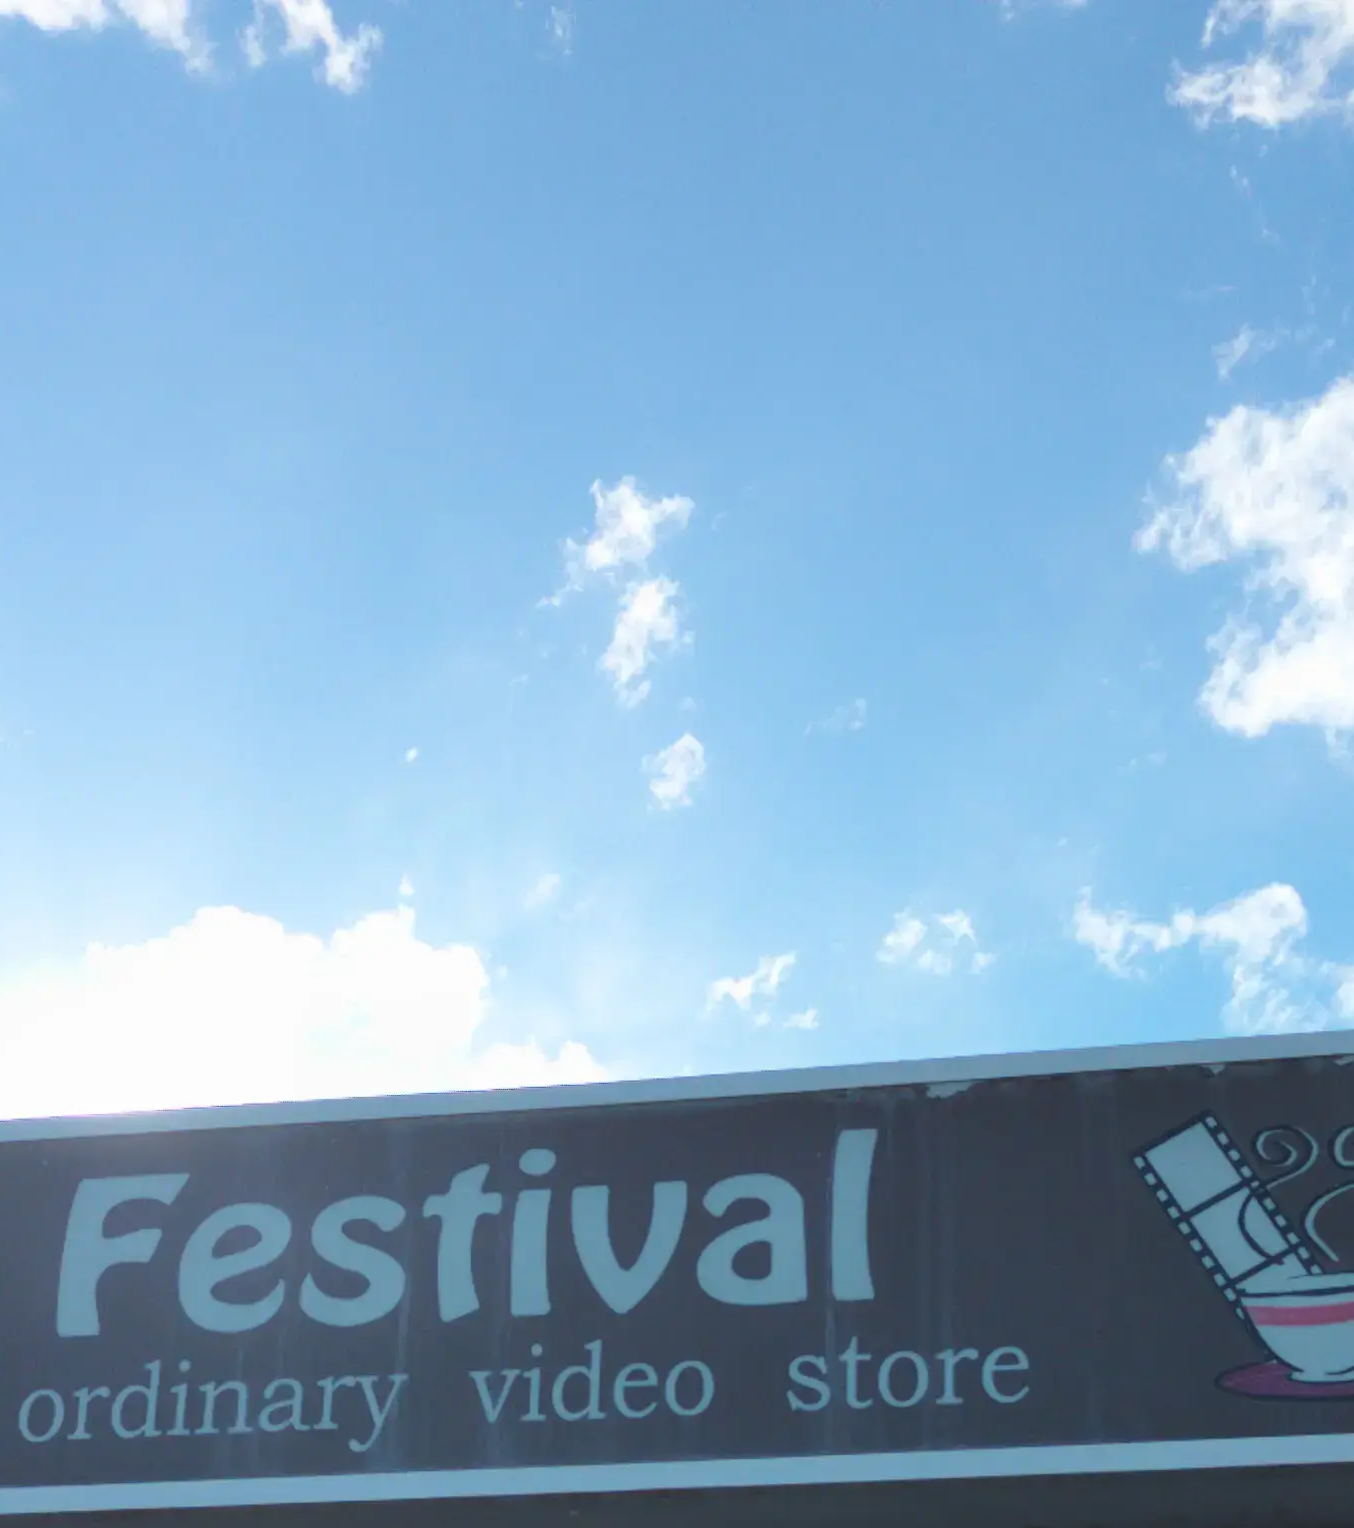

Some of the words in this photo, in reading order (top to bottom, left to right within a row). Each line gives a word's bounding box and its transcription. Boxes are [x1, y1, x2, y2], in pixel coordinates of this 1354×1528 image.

[56, 1129, 878, 1337] Festival
[18, 1360, 408, 1452] ordinary
[470, 1340, 714, 1424] video
[787, 1337, 1030, 1412] store
